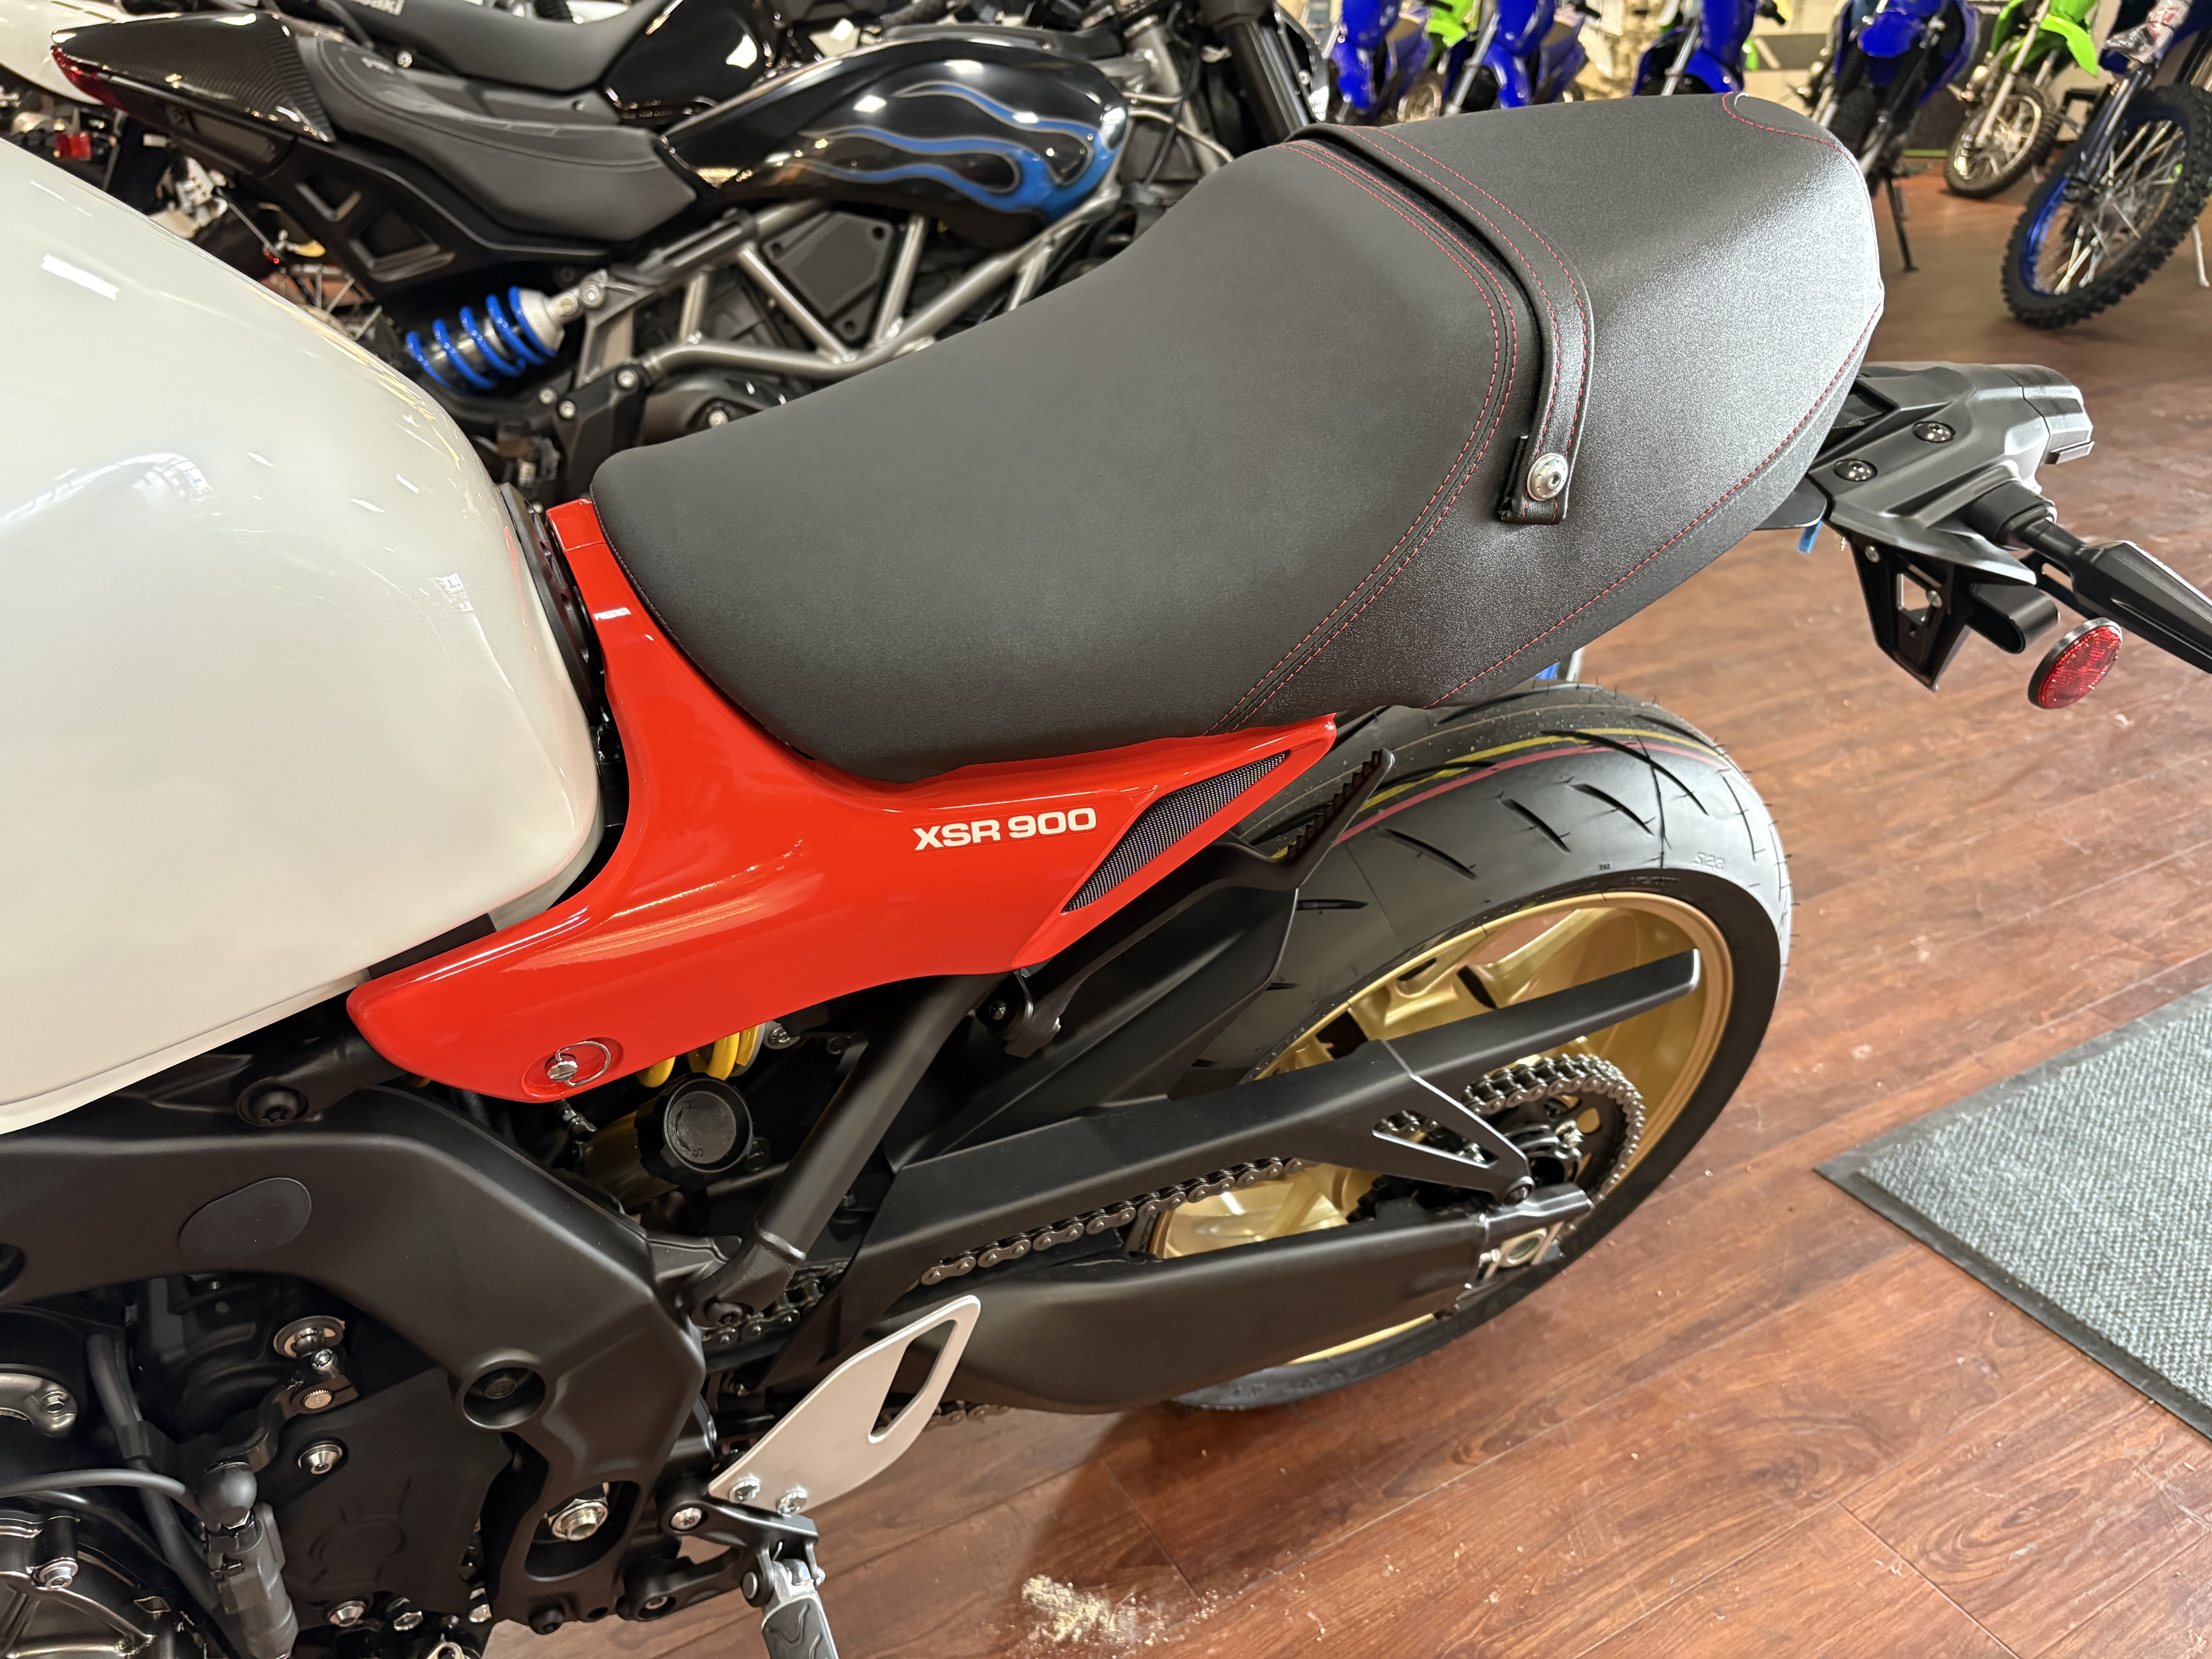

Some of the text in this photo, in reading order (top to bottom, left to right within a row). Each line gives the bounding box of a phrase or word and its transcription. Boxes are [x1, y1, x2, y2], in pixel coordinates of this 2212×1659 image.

[913, 807, 1096, 851] XSR 900
[692, 1147, 704, 1158] S
